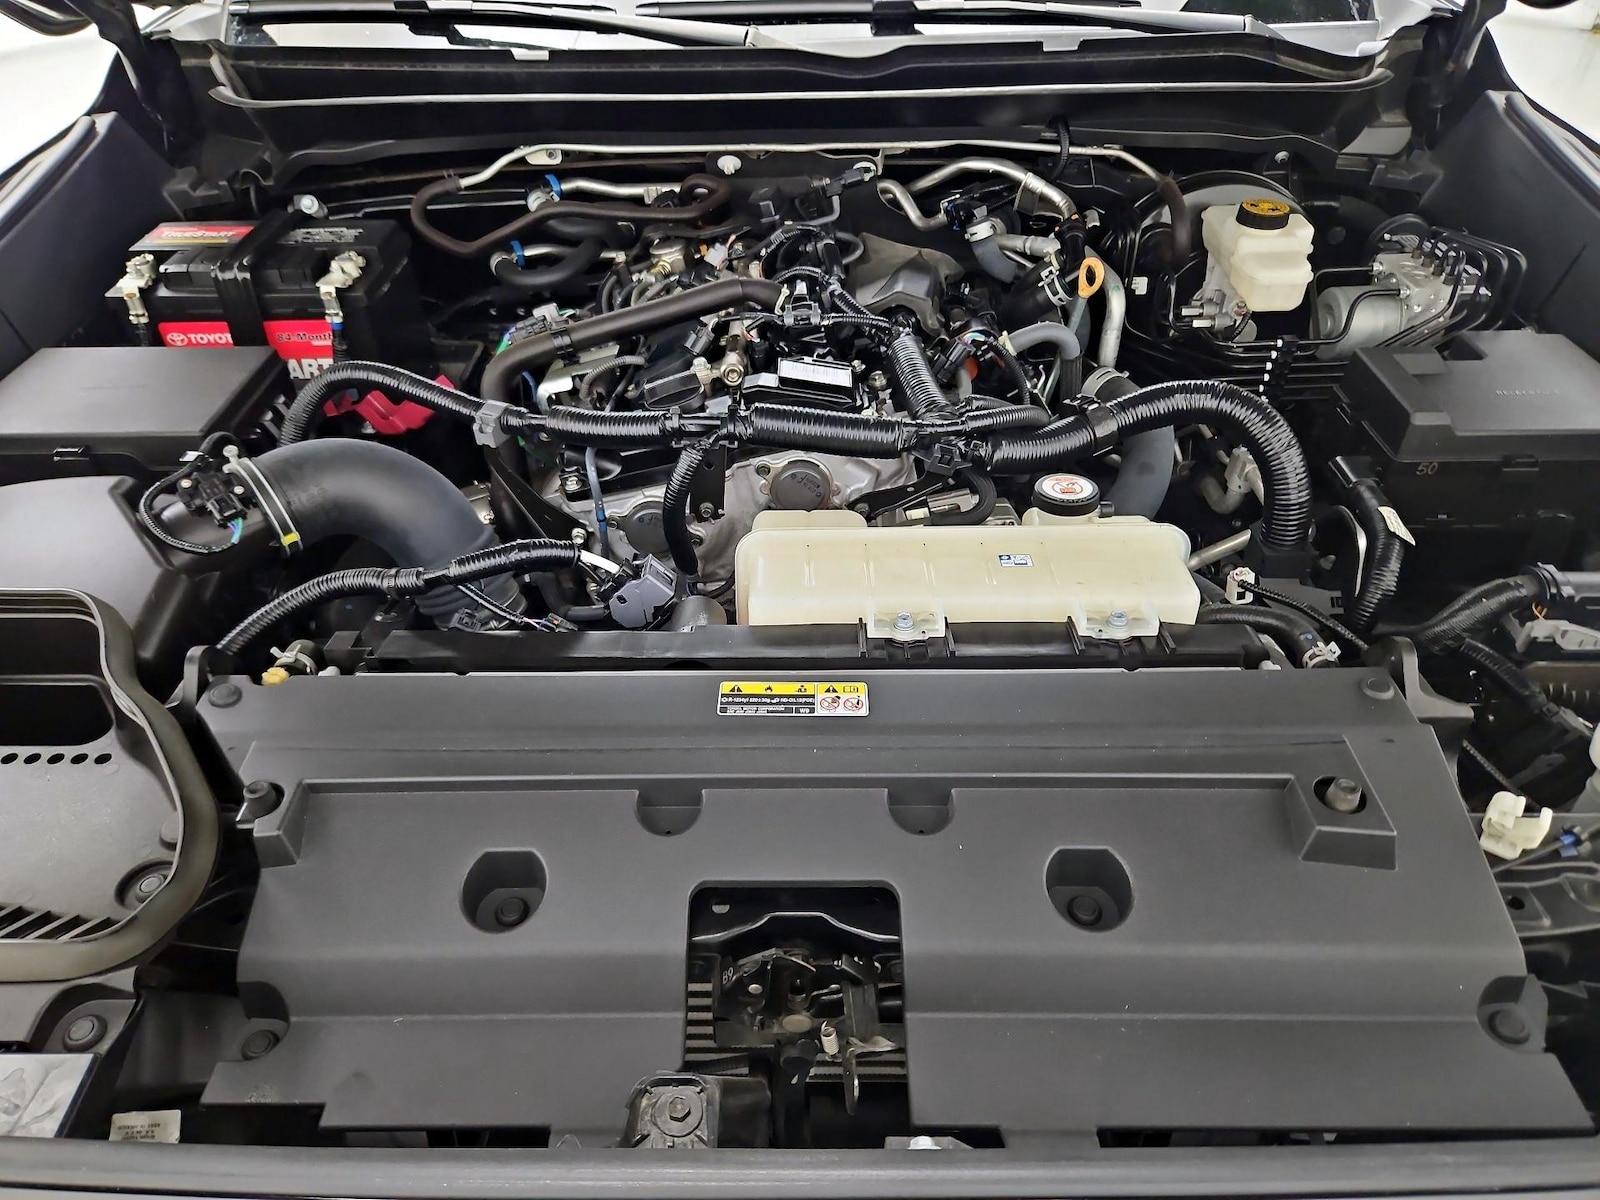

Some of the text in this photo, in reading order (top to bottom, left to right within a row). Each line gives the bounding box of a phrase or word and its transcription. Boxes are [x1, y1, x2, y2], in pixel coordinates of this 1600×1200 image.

[188, 333, 232, 344] TOYOT
[287, 358, 334, 380] ART
[1415, 462, 1438, 475] 50
[722, 966, 734, 985] B9
